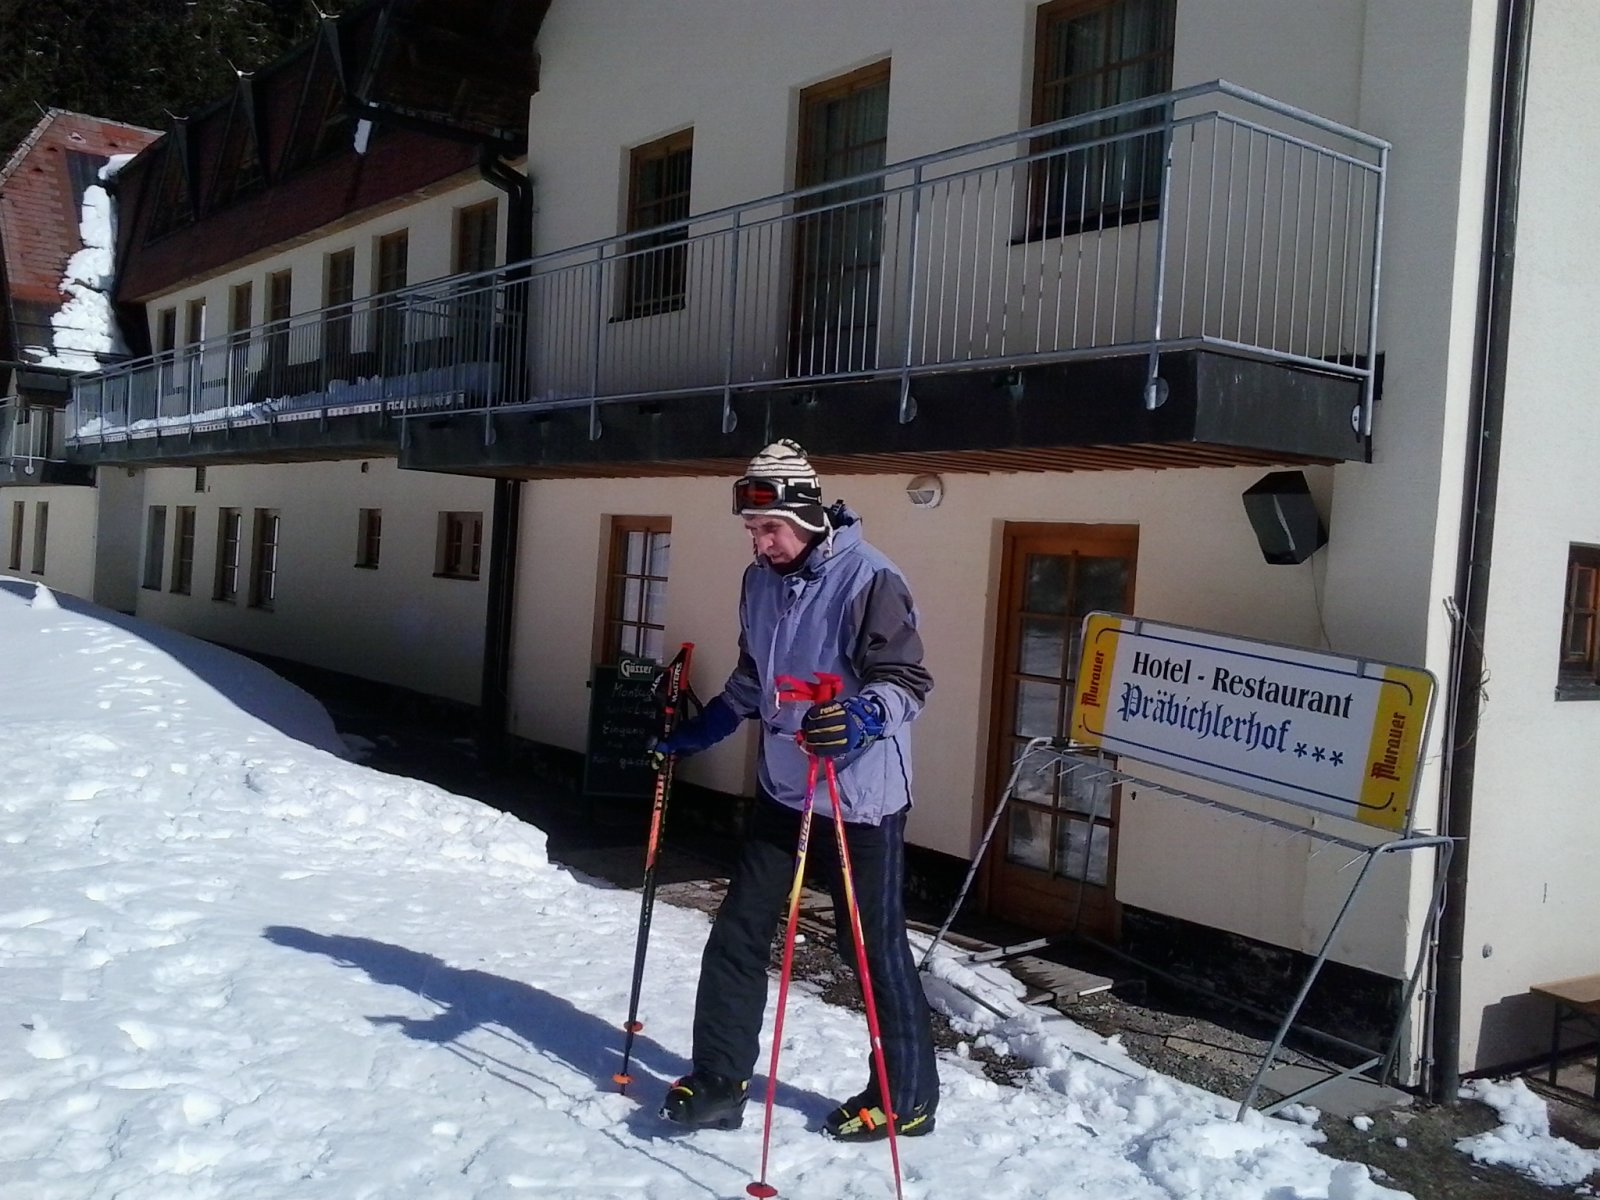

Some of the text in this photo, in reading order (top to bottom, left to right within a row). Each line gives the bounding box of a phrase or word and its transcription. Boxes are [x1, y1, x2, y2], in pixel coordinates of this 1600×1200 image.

[620, 659, 653, 678] Gösser
[1081, 650, 1105, 707] Murauer
[1132, 651, 1192, 684] Hotel
[1212, 667, 1353, 719] Restaurant
[1117, 682, 1291, 752] Präbichlerhof
[1371, 711, 1407, 781] Murauer
